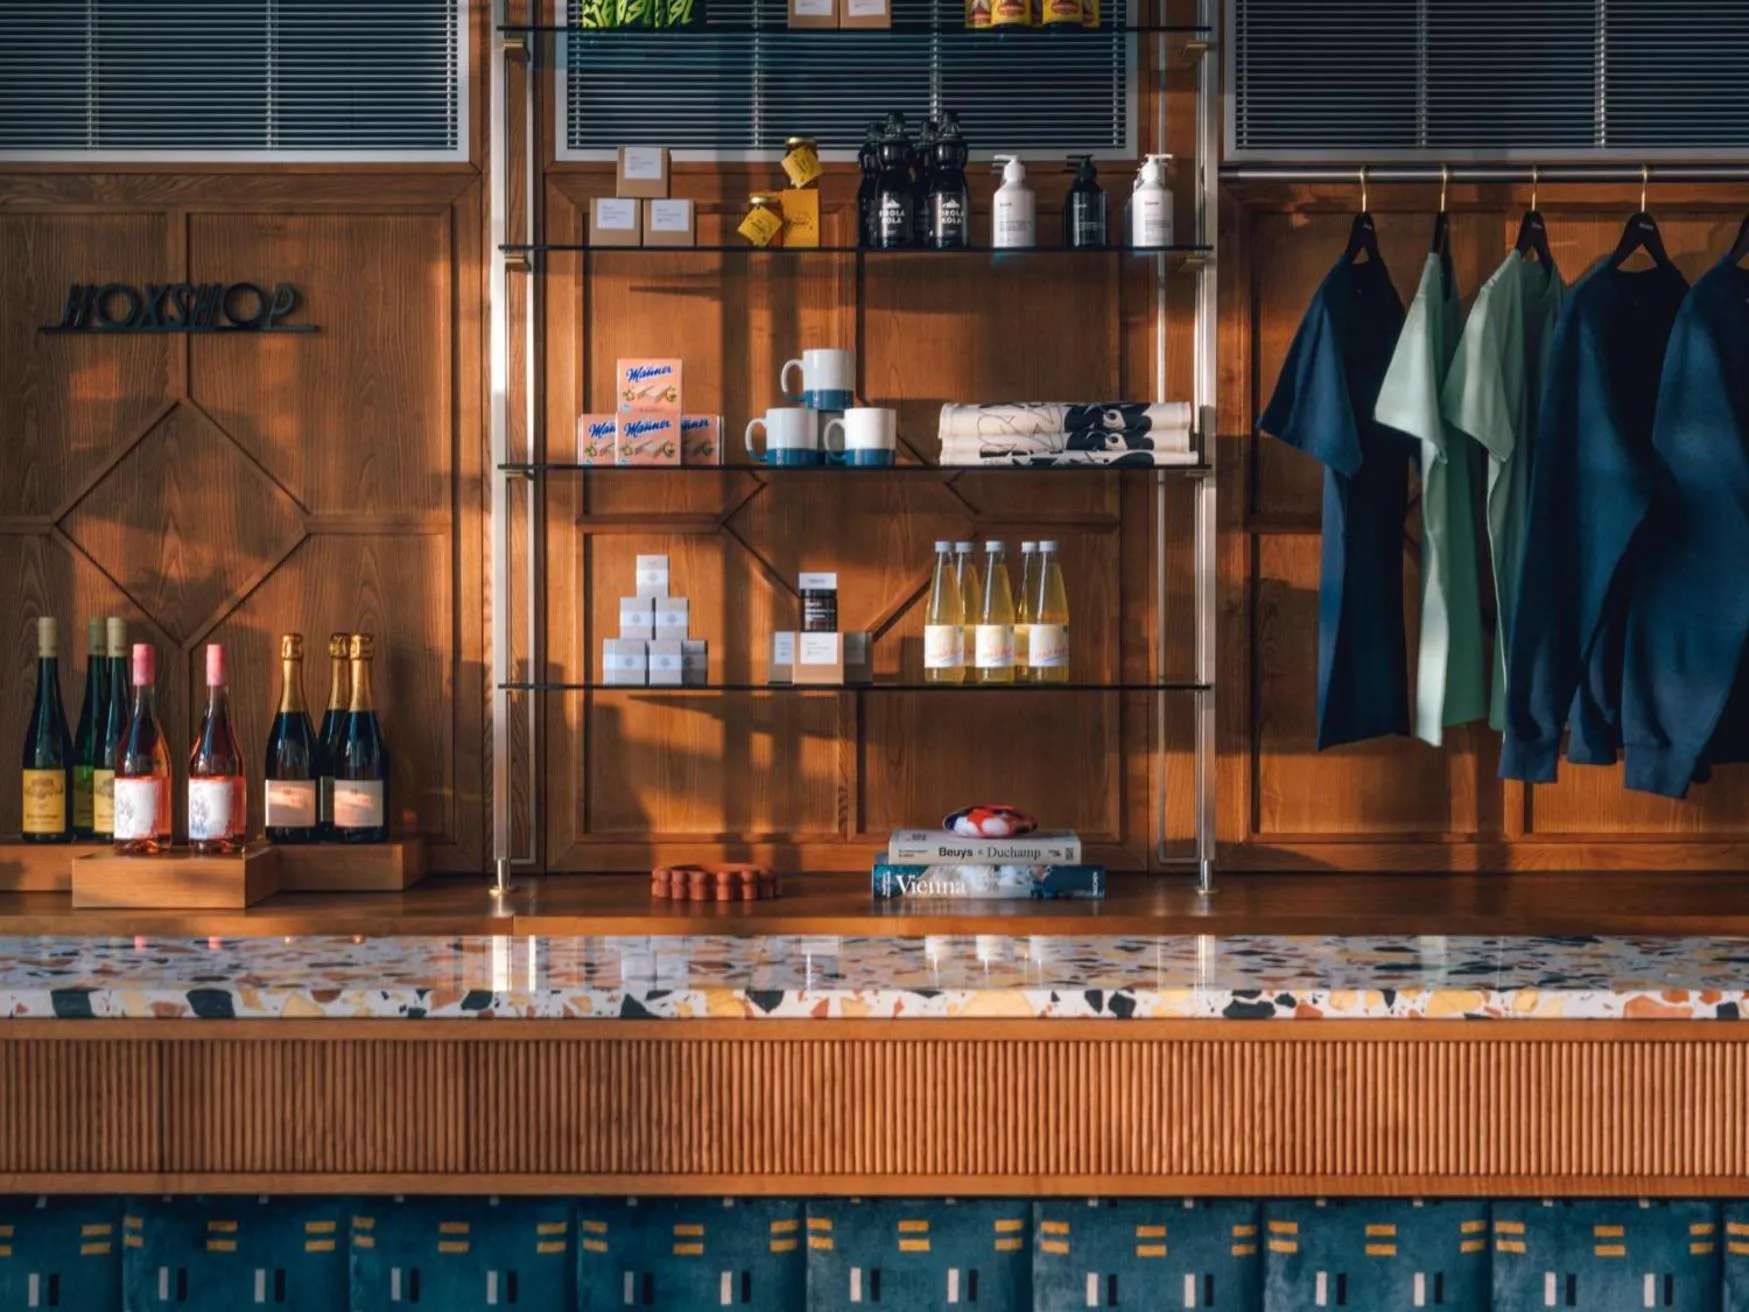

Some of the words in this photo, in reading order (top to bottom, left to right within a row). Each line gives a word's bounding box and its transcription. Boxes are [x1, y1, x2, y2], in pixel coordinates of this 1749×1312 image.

[60, 282, 301, 328] HOXSHOP
[939, 846, 974, 861] Beuys
[987, 847, 1042, 861] Duchamp
[896, 874, 966, 897] Vienna
